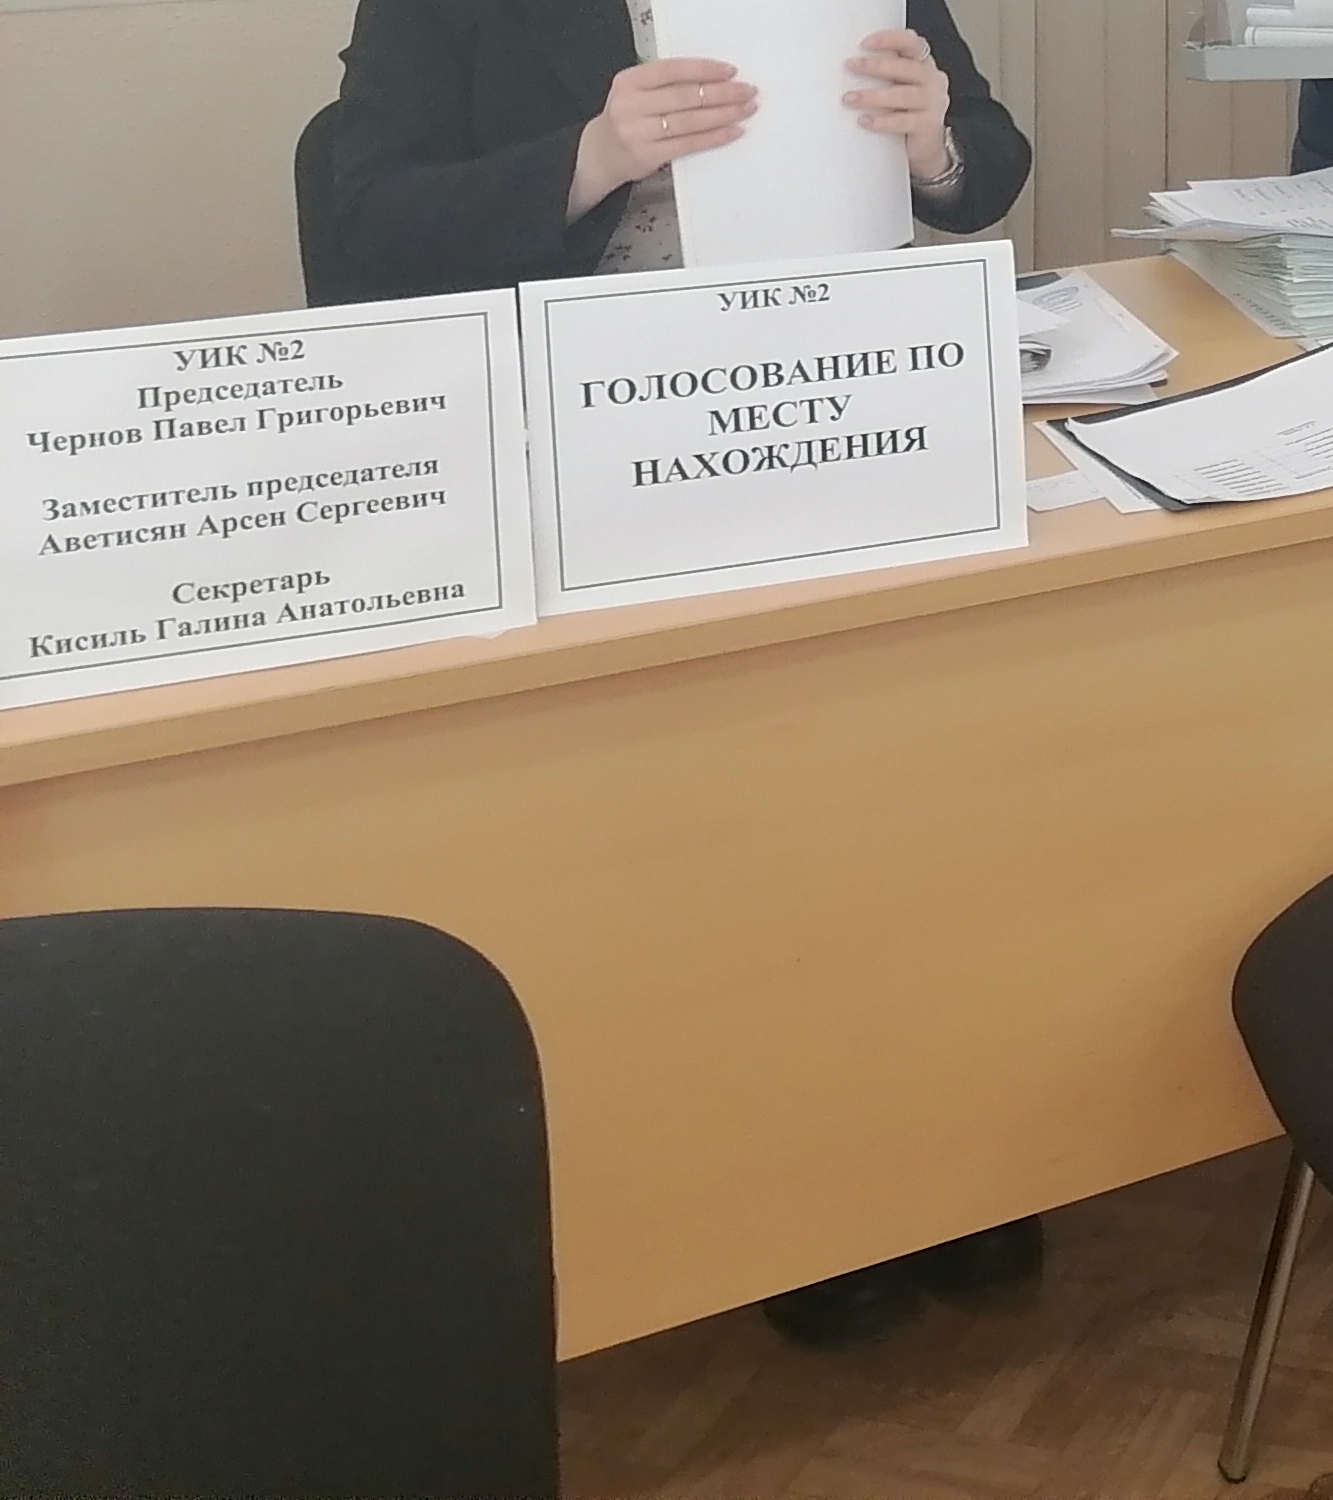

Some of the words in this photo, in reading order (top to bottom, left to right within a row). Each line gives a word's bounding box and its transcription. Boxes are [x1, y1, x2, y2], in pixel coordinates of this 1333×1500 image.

[719, 288, 782, 312] УИК
[788, 283, 831, 305] №2
[173, 344, 248, 372] УИК
[256, 339, 306, 363] №2
[580, 348, 898, 408] ГОЛОСОВАНИЕ
[908, 341, 966, 372] ПО
[136, 371, 344, 412] Председатель
[707, 395, 853, 436] МЕСТУ
[26, 426, 143, 457] Чернов
[152, 414, 247, 442] Павел
[256, 392, 448, 434] Григорьевич
[632, 425, 928, 487] НАХОЖДЕНИЯ
[41, 480, 239, 522] Заместитель
[246, 457, 440, 501] председателя
[37, 521, 188, 556] Аветисян
[196, 509, 287, 541] Арсен
[296, 488, 447, 525] Сергеевич
[172, 567, 332, 605] Секретарь
[28, 627, 148, 658] Кисиль
[154, 610, 267, 641] Галина
[275, 581, 466, 624] Анатольевна
